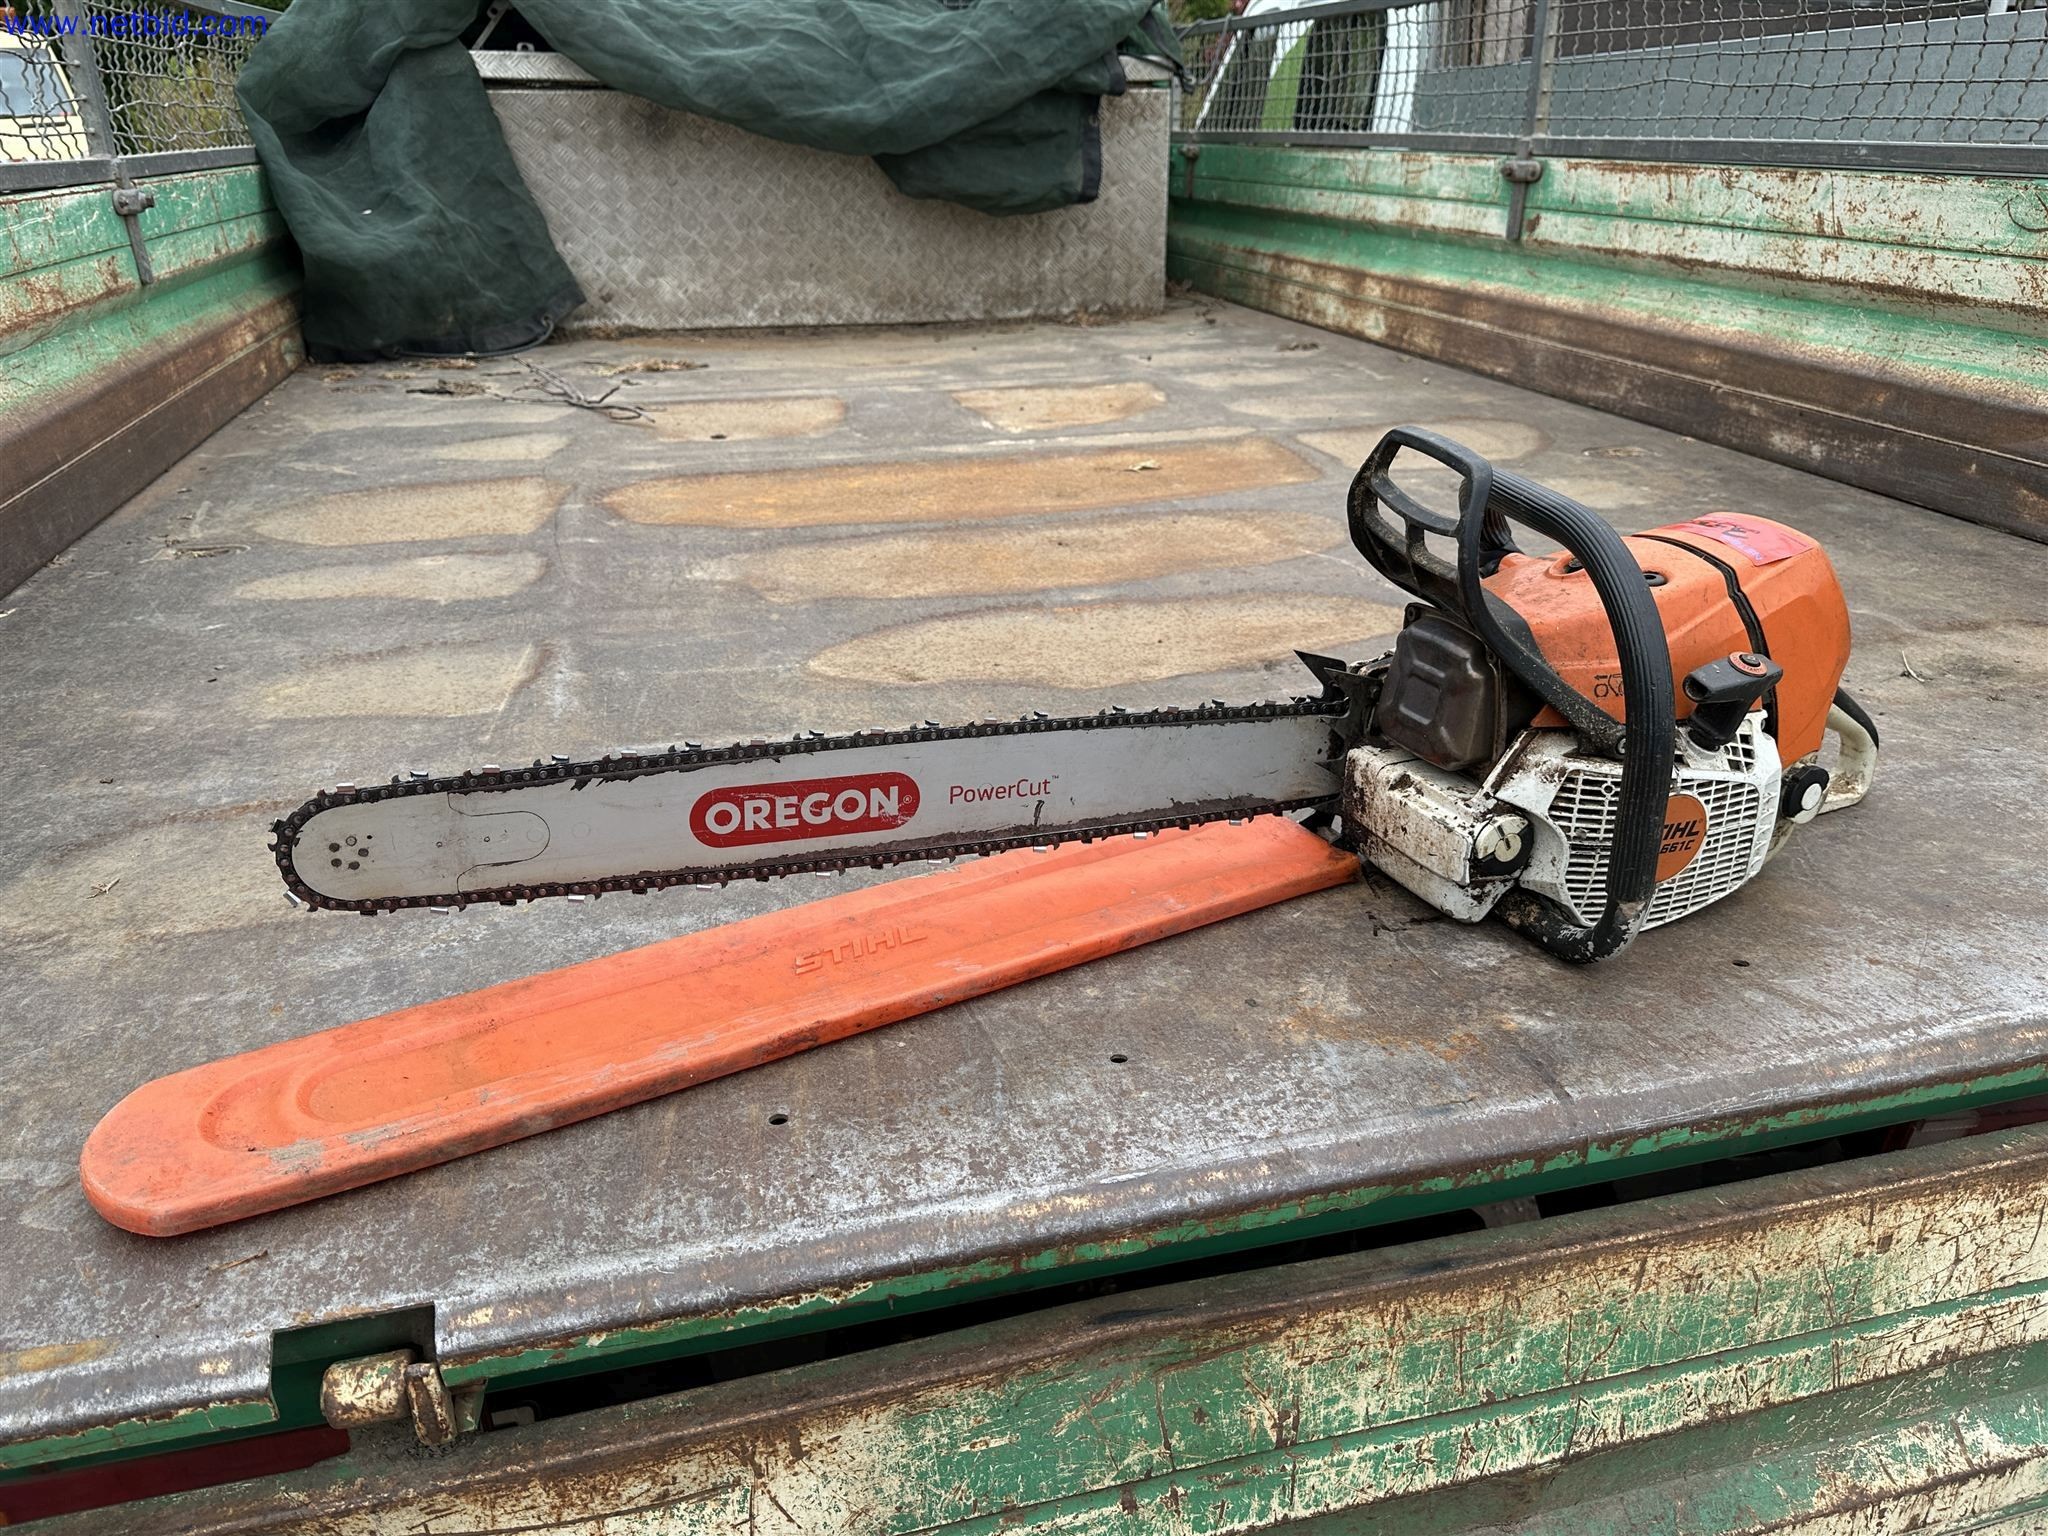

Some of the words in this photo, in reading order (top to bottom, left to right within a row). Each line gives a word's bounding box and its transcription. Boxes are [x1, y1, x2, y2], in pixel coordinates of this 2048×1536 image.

[704, 785, 899, 835] OREGON
[949, 778, 1051, 804] PowerCut
[1662, 820, 1700, 841] IHL
[794, 925, 928, 976] STIHL
